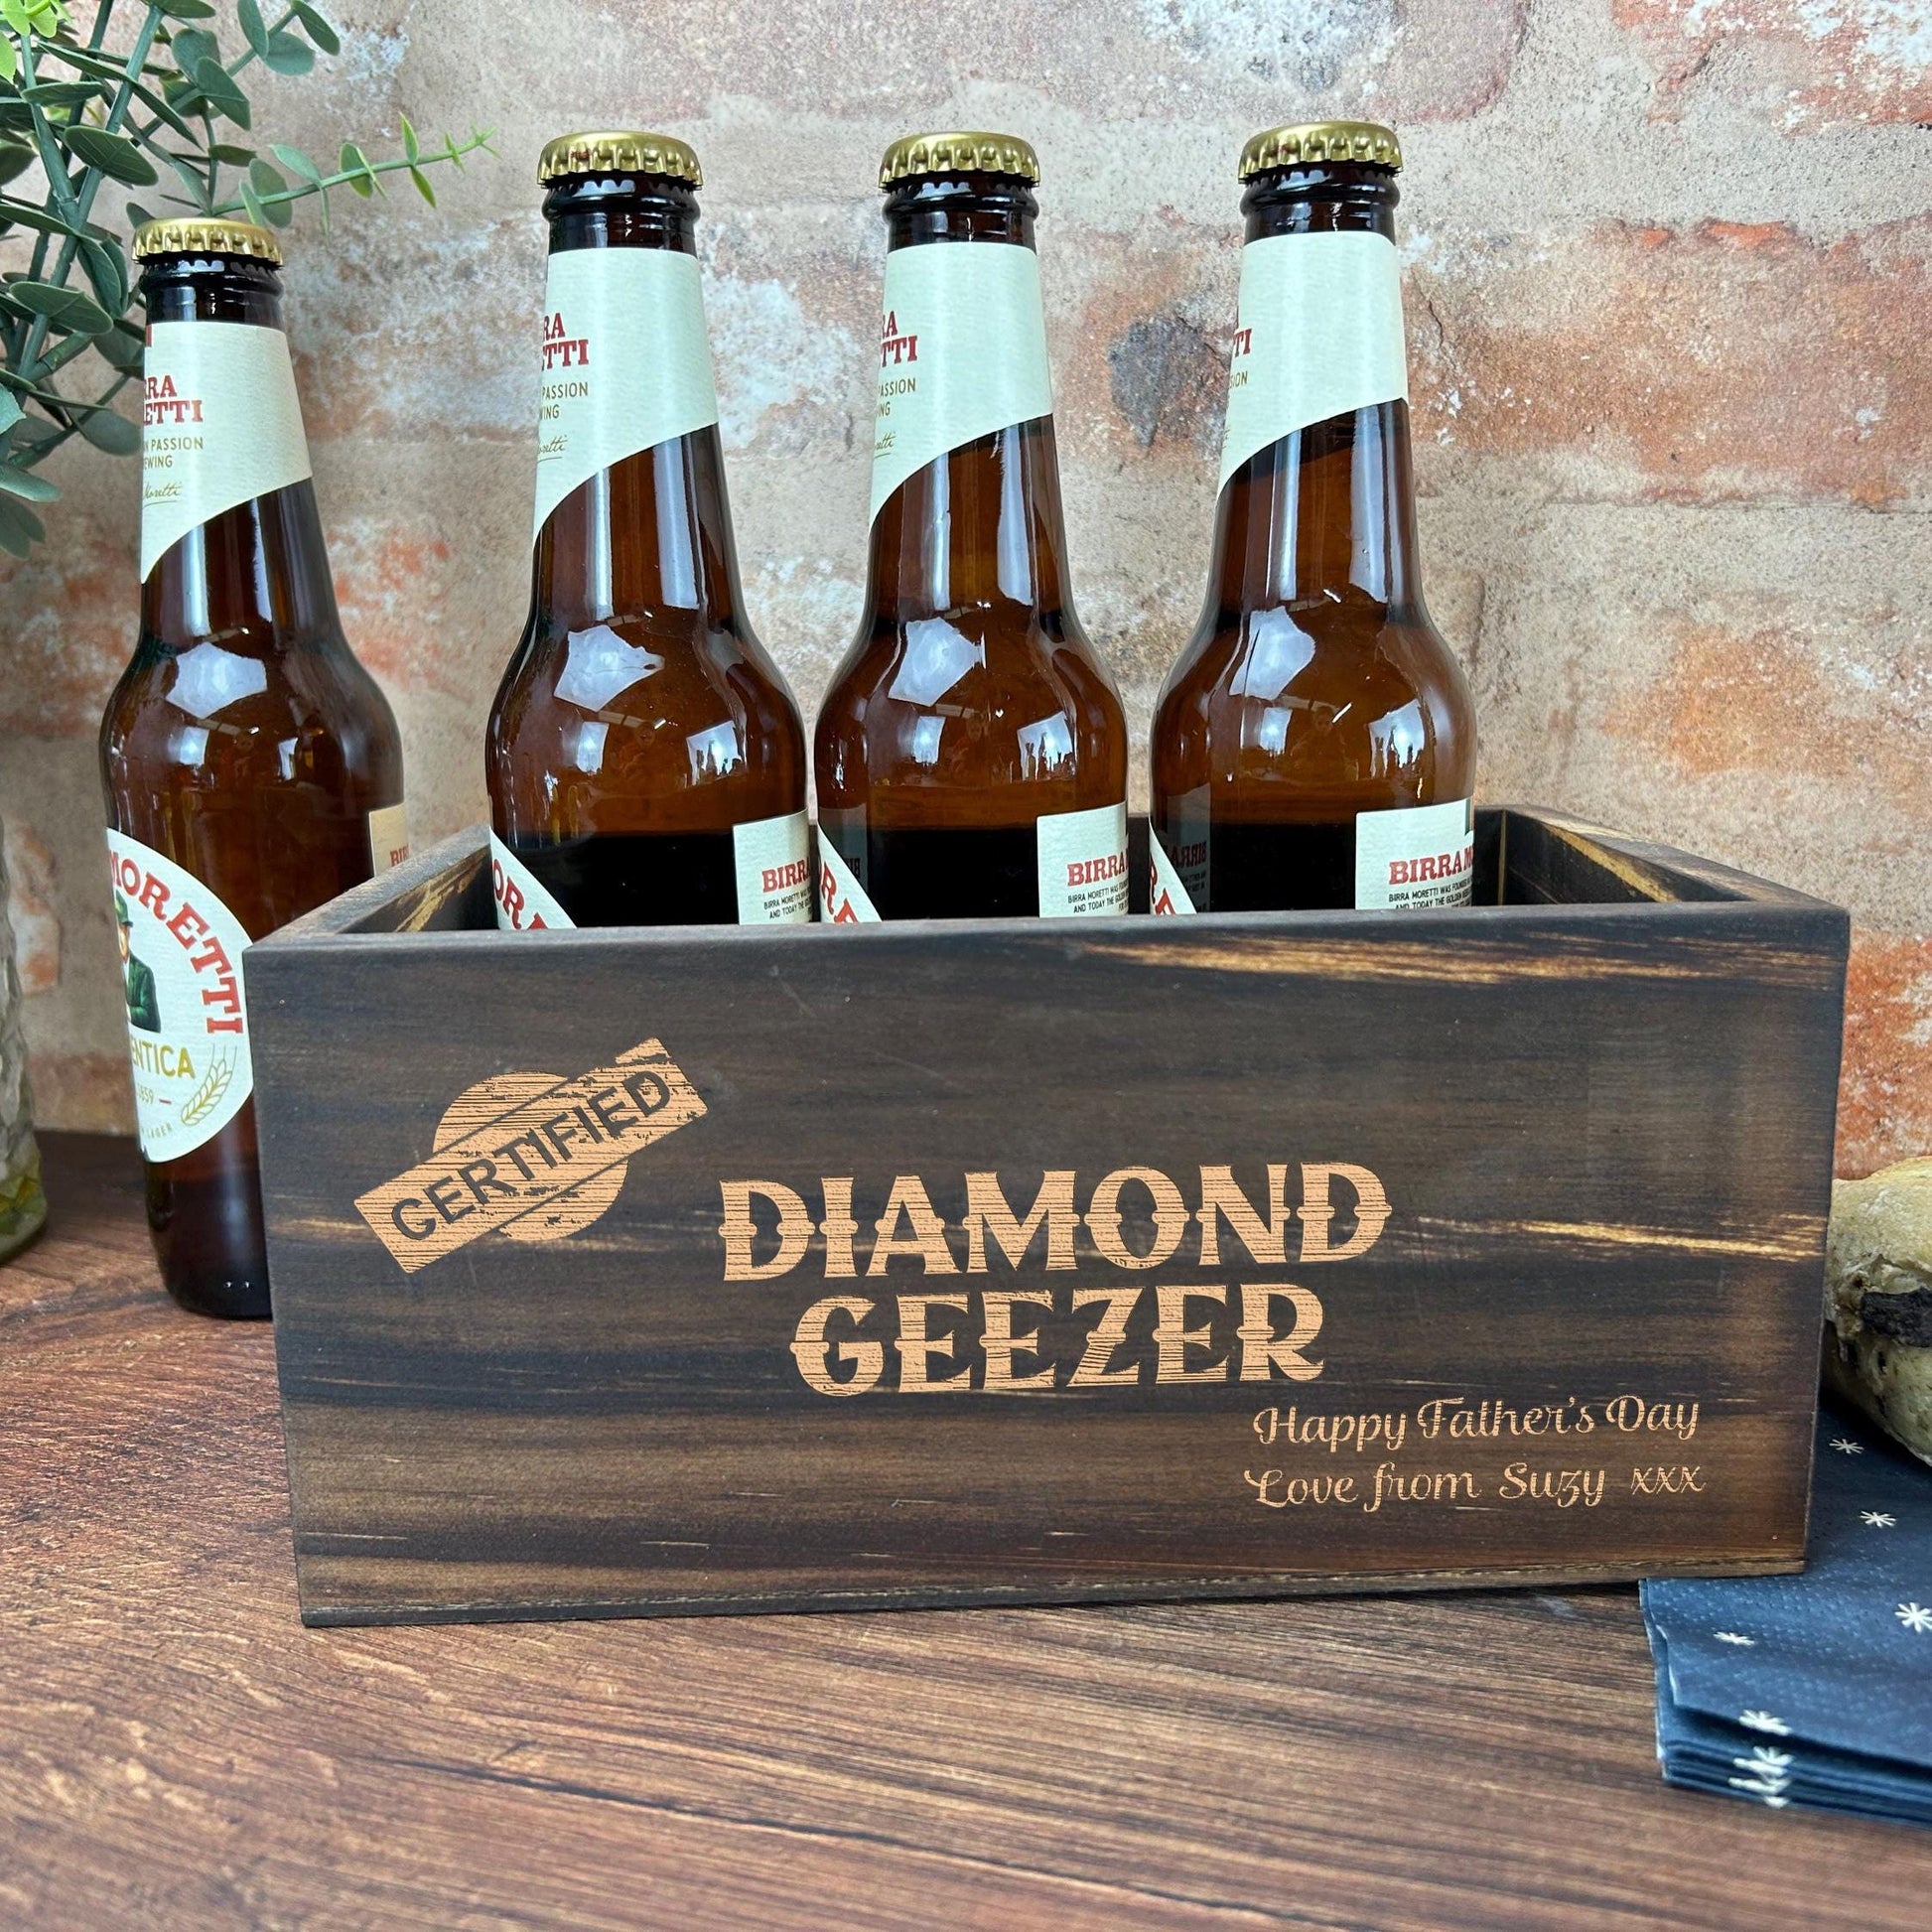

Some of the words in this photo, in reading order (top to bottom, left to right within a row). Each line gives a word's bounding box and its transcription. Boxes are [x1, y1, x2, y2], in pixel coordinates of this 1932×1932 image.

[1087, 887, 1109, 900] MORETTI
[1388, 851, 1462, 885] BIRRA
[1073, 903, 1086, 914] AND
[1087, 899, 1106, 910] TODAY
[1388, 893, 1410, 902] BIRRA
[1412, 888, 1438, 899] MORETTI
[391, 1070, 673, 1241] CERTIFIED
[718, 1162, 1393, 1282] DIAMOND
[789, 1283, 1325, 1397] GEEZER
[1252, 1405, 1408, 1453] Happy
[1417, 1396, 1595, 1439] Father's
[1604, 1395, 1701, 1441] Day
[1243, 1468, 1358, 1509] Love
[1362, 1461, 1483, 1513] from
[1497, 1462, 1607, 1508] Suzy
[1630, 1464, 1707, 1496] xxx
